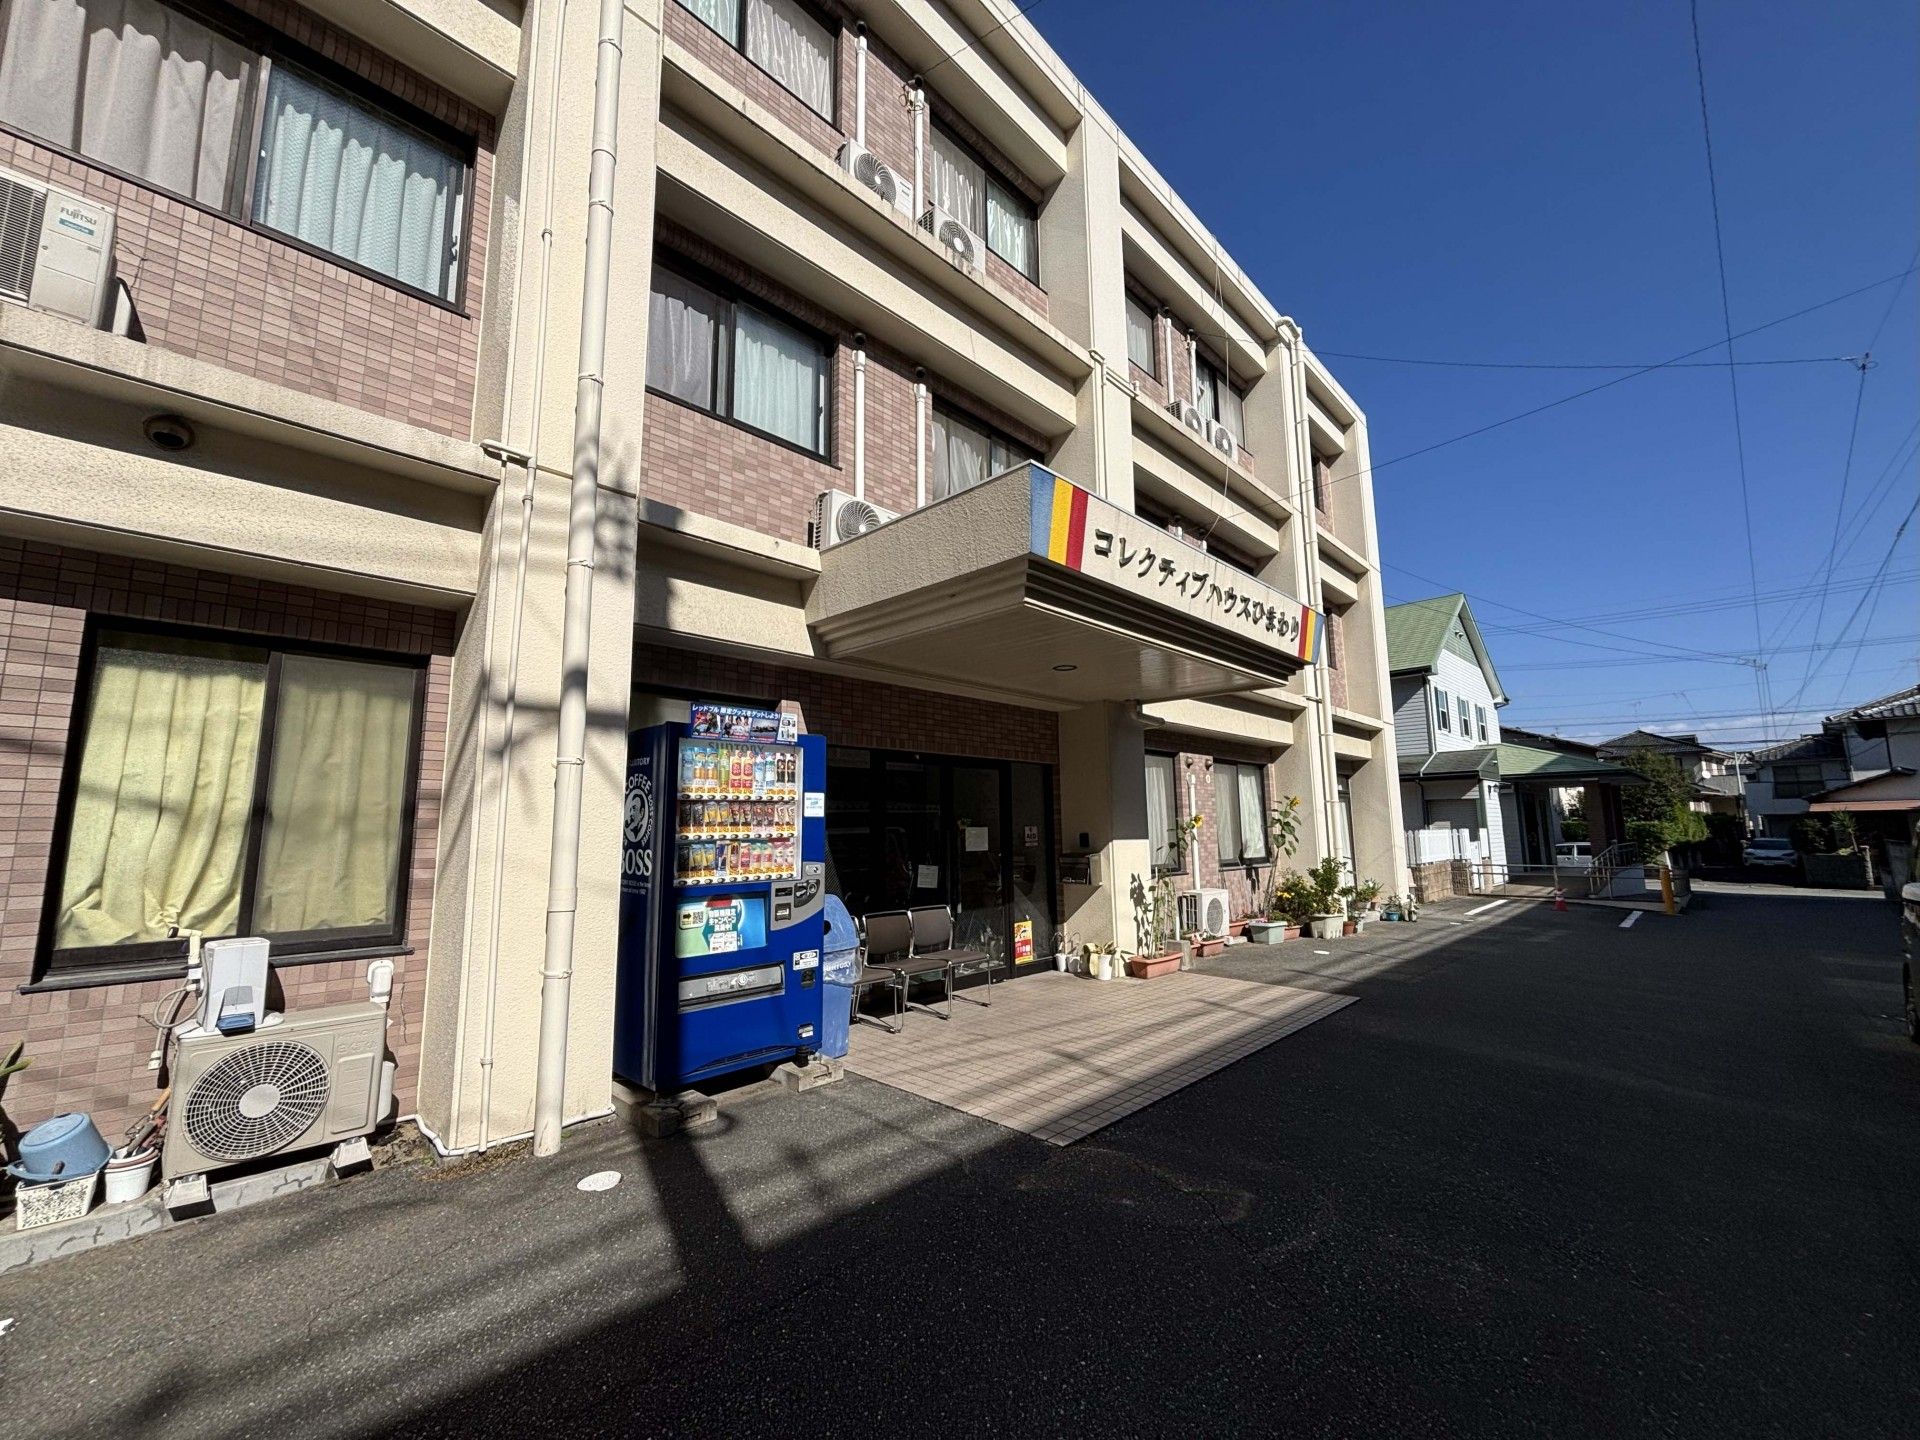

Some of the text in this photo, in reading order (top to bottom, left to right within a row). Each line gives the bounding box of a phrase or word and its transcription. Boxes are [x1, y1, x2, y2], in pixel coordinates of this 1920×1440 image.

[60, 207, 97, 225] FUJITSU
[692, 704, 719, 714] レッドブル
